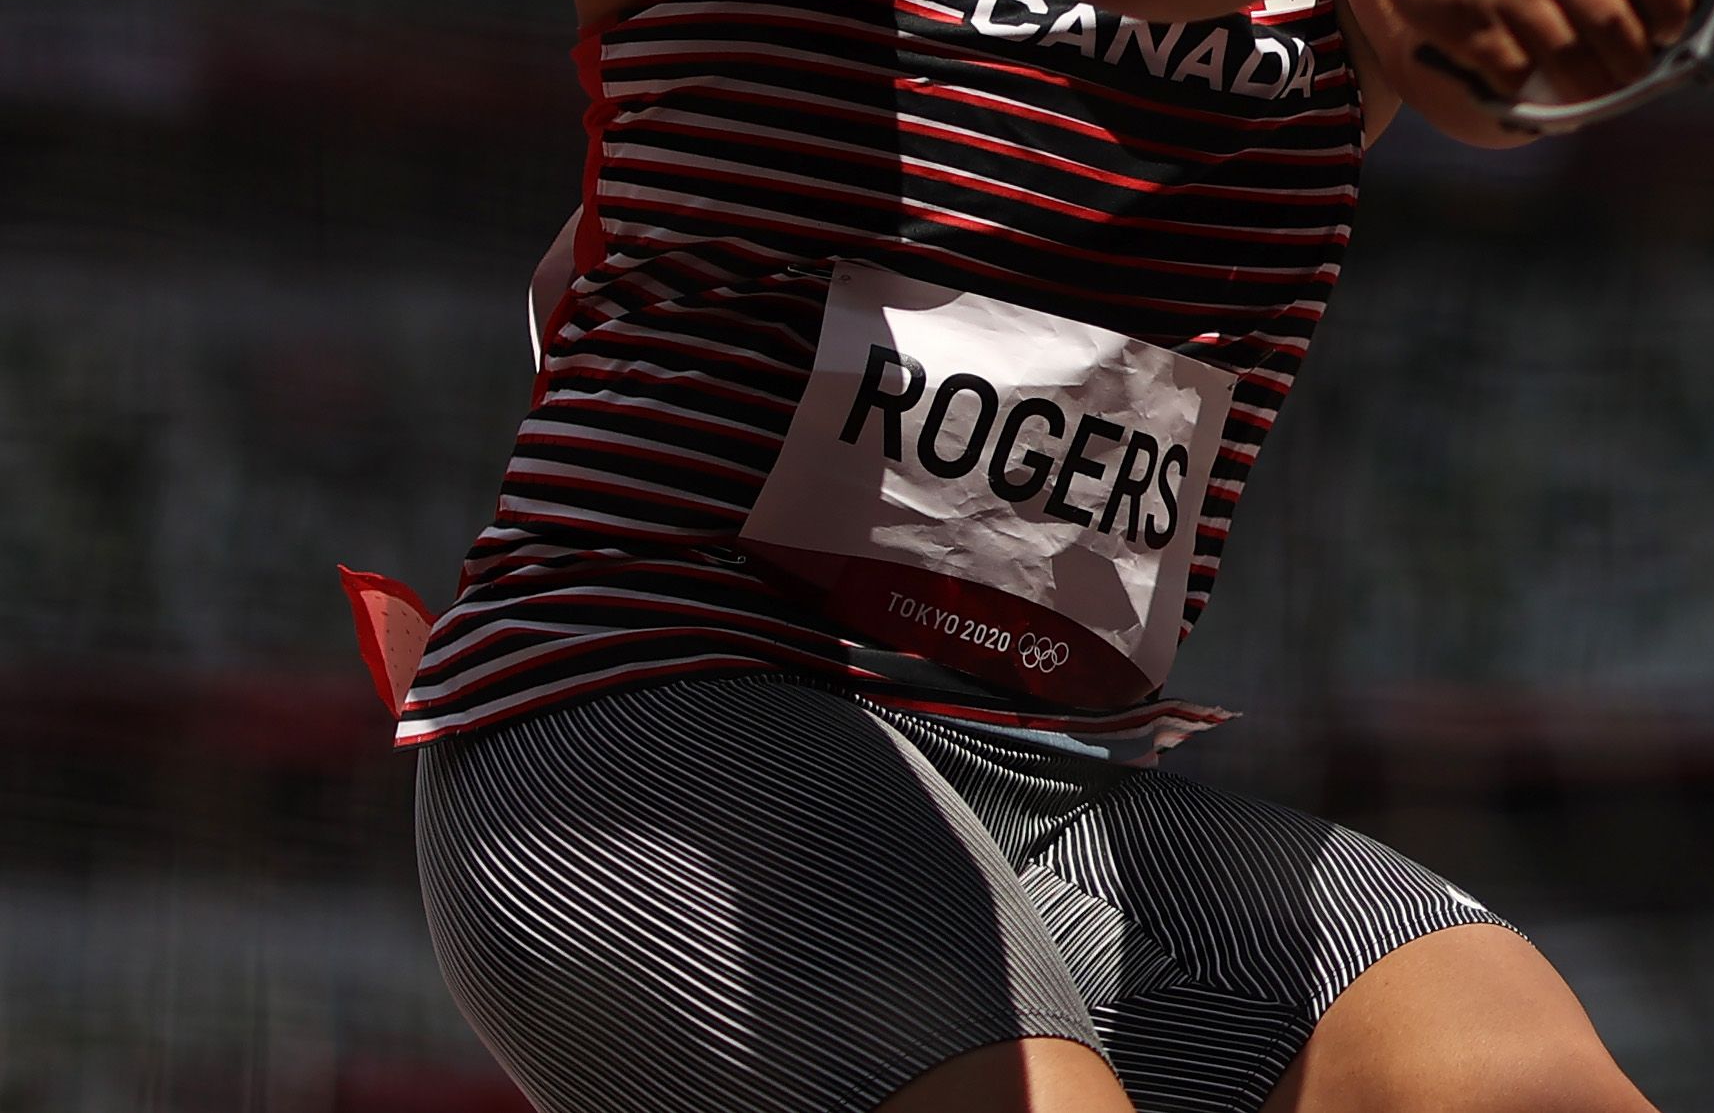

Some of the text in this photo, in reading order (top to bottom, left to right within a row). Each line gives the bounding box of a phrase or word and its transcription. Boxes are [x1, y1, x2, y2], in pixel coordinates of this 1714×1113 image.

[839, 343, 1189, 550] ROGERS
[887, 591, 1011, 653] TOKYO 2020
